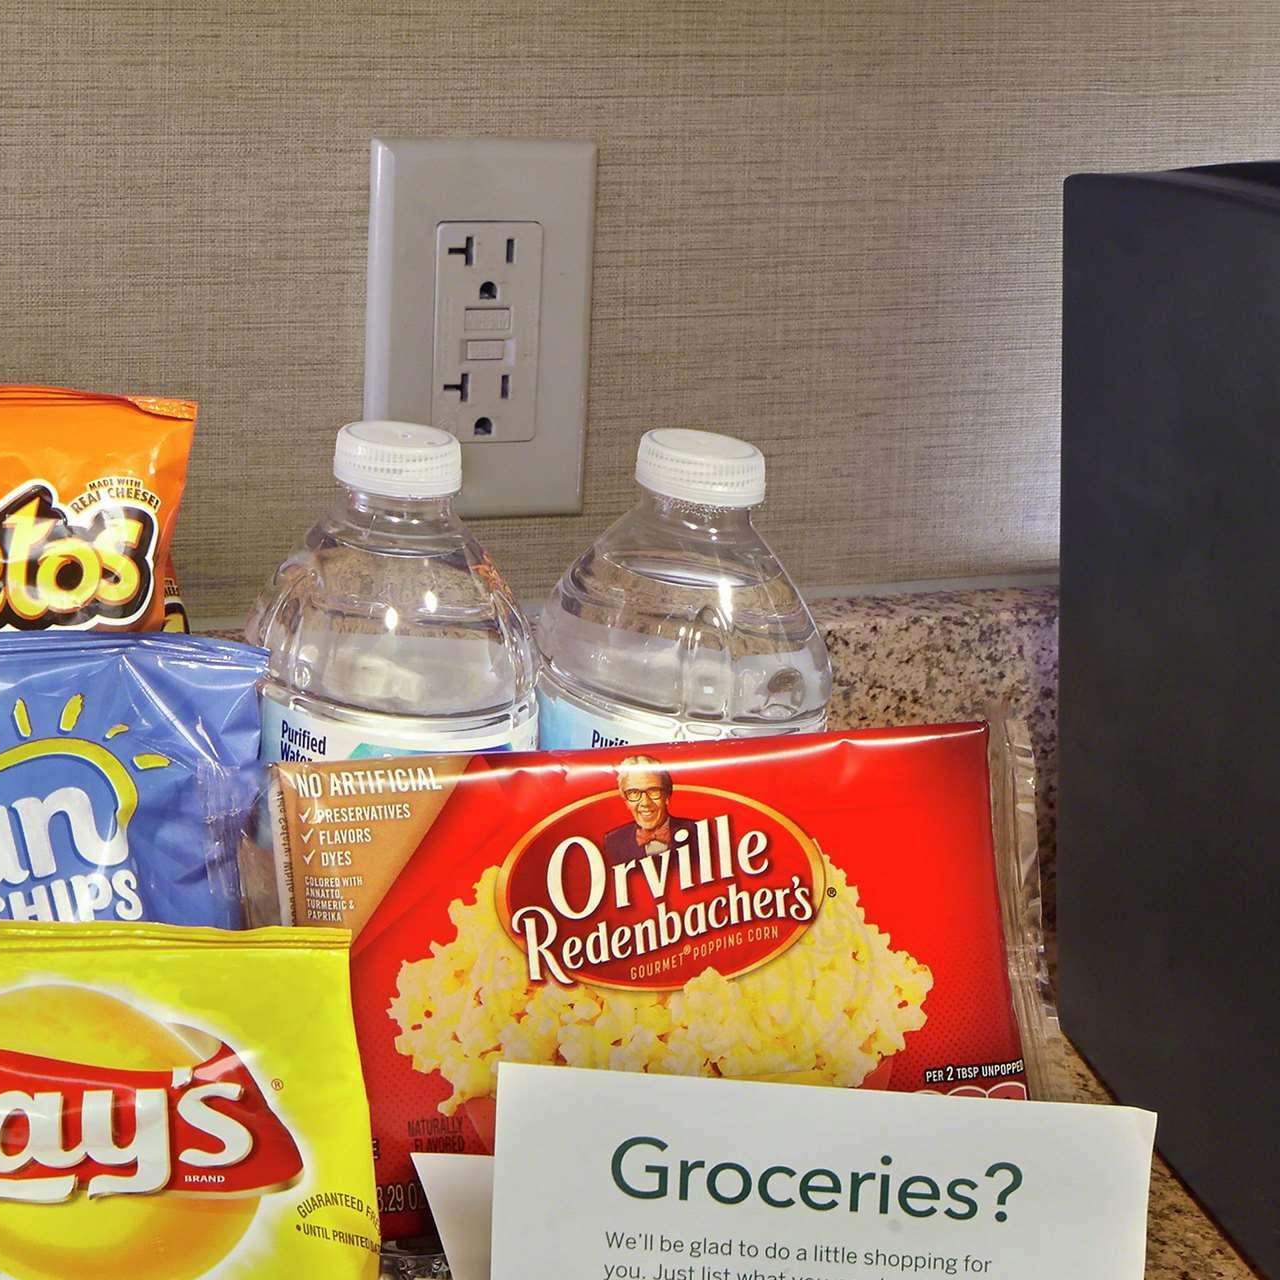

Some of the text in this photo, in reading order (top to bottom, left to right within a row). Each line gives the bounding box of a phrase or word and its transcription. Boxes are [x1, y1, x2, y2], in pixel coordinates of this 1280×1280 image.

[281, 720, 327, 756] Purified
[295, 767, 443, 798] NO ARTIFICIAL
[316, 804, 411, 823] PRESERVATIVES
[319, 828, 372, 845] FLAVORS
[321, 851, 352, 867] DYES
[546, 815, 769, 920] Orville
[304, 876, 363, 888] COLORED WITH
[511, 875, 813, 985] Redenbacher's
[692, 925, 779, 961] POPPING CORN
[926, 1066, 980, 1082] PER 2 TBSP
[407, 1116, 465, 1138] NATURALLY
[183, 1173, 226, 1184] BRAND
[610, 1135, 1024, 1222] Groceries?
[296, 1191, 364, 1219] GUARANTEED
[302, 1223, 331, 1241] UNTIL
[332, 1230, 371, 1251] PRINTED
[605, 1231, 993, 1275] We'll be glad to do a little shopping for
[602, 1263, 646, 1280] you.
